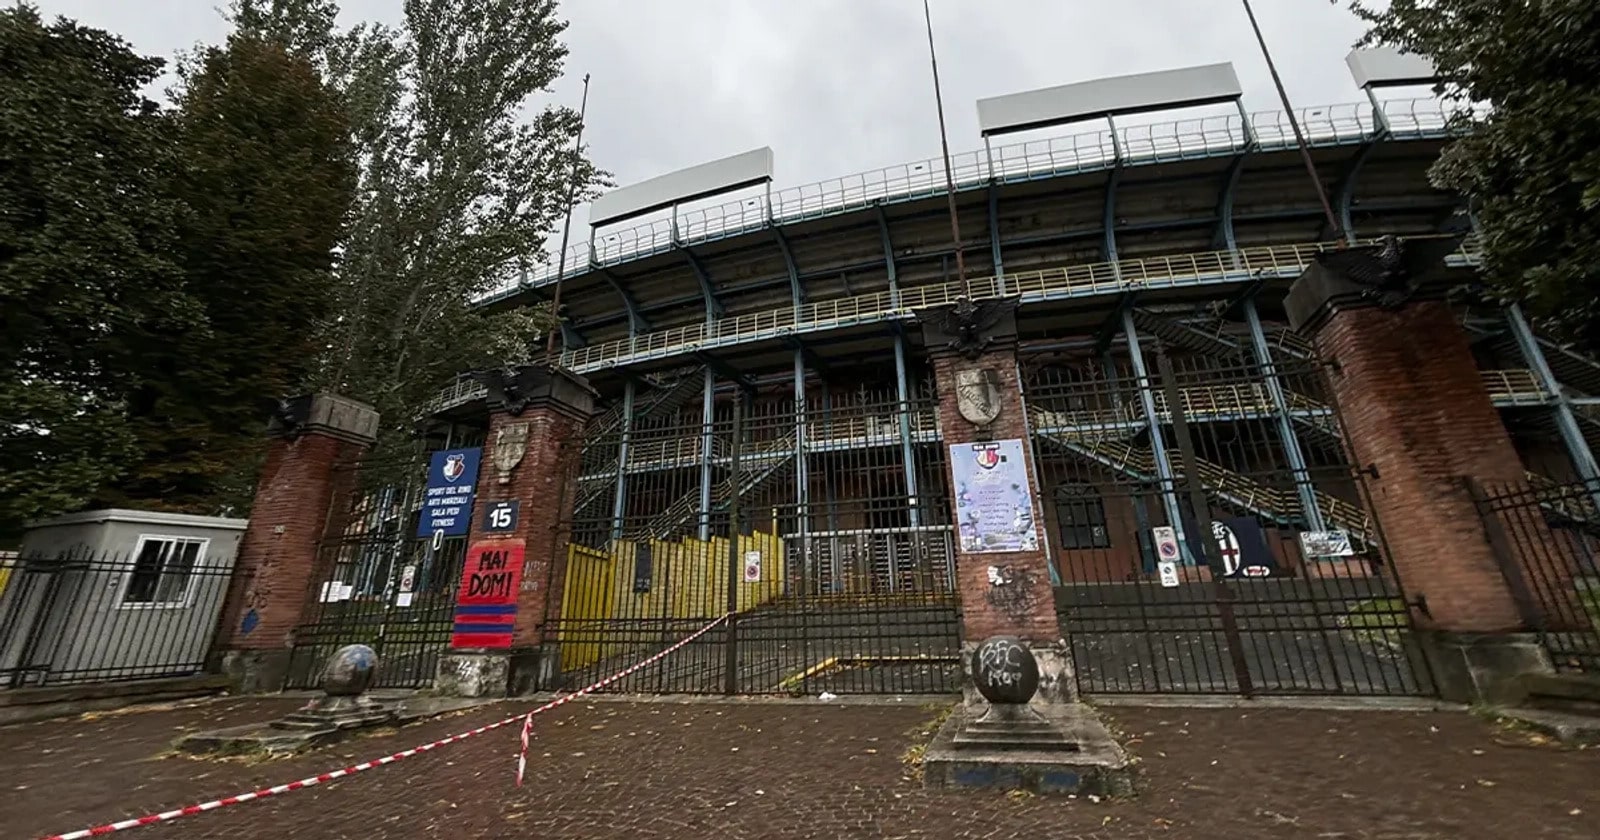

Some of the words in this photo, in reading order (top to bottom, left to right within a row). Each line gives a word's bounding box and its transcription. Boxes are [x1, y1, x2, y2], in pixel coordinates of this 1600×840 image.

[431, 508, 446, 517] SALA
[431, 518, 455, 527] FITNESS
[490, 508, 512, 528] 15
[478, 550, 509, 571] MAI
[467, 571, 513, 597] DOMI
